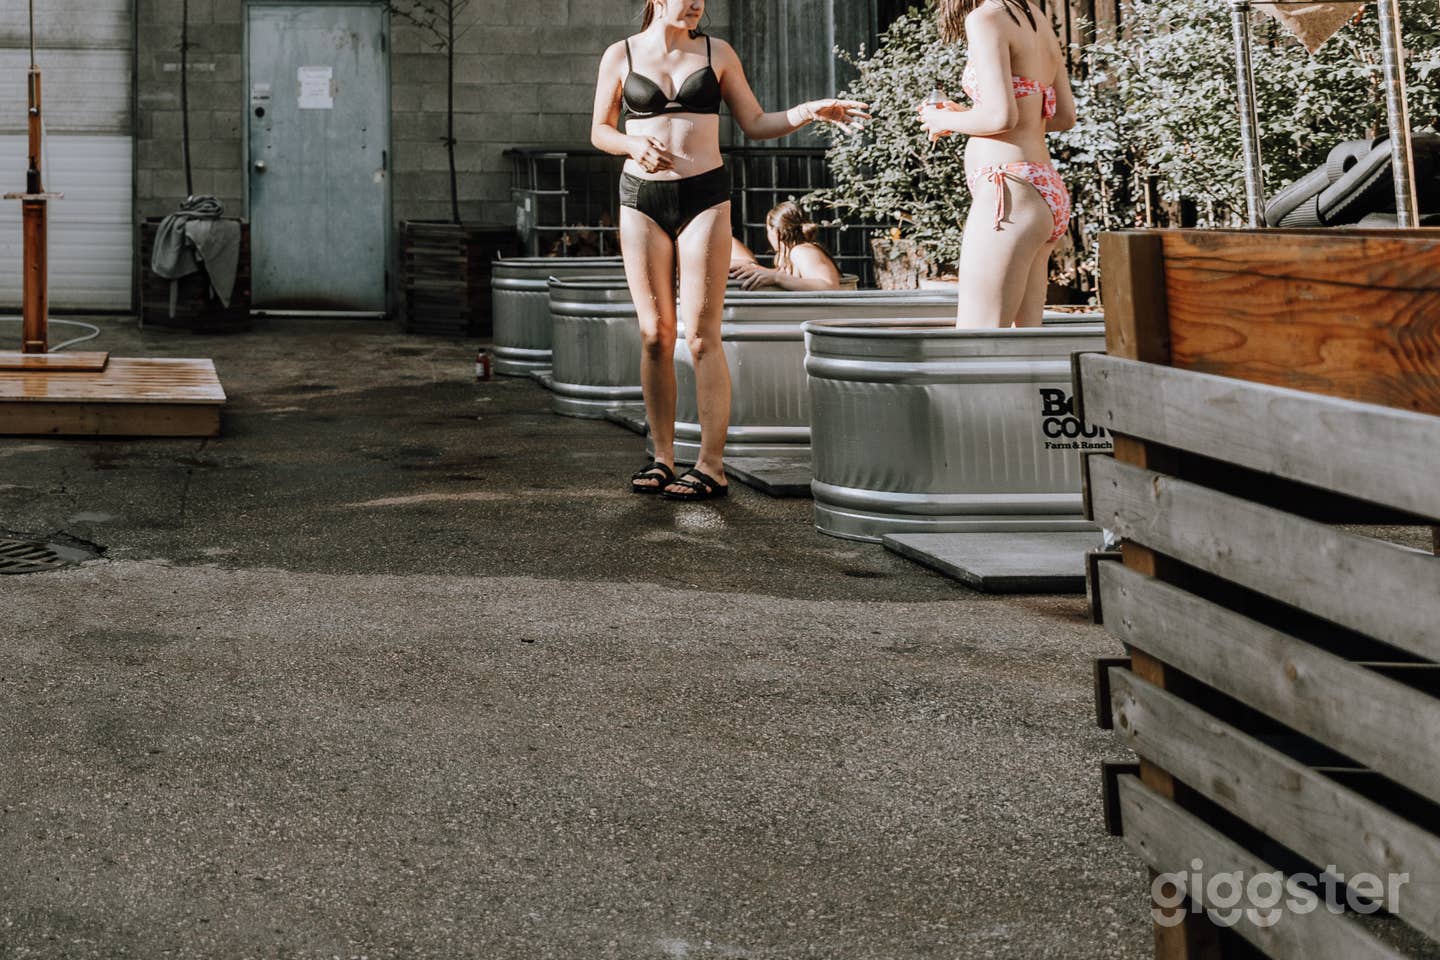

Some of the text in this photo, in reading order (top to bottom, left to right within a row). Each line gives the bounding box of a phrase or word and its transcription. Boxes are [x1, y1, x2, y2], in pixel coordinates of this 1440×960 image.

[1045, 441, 1113, 450] Farm & Ranch
